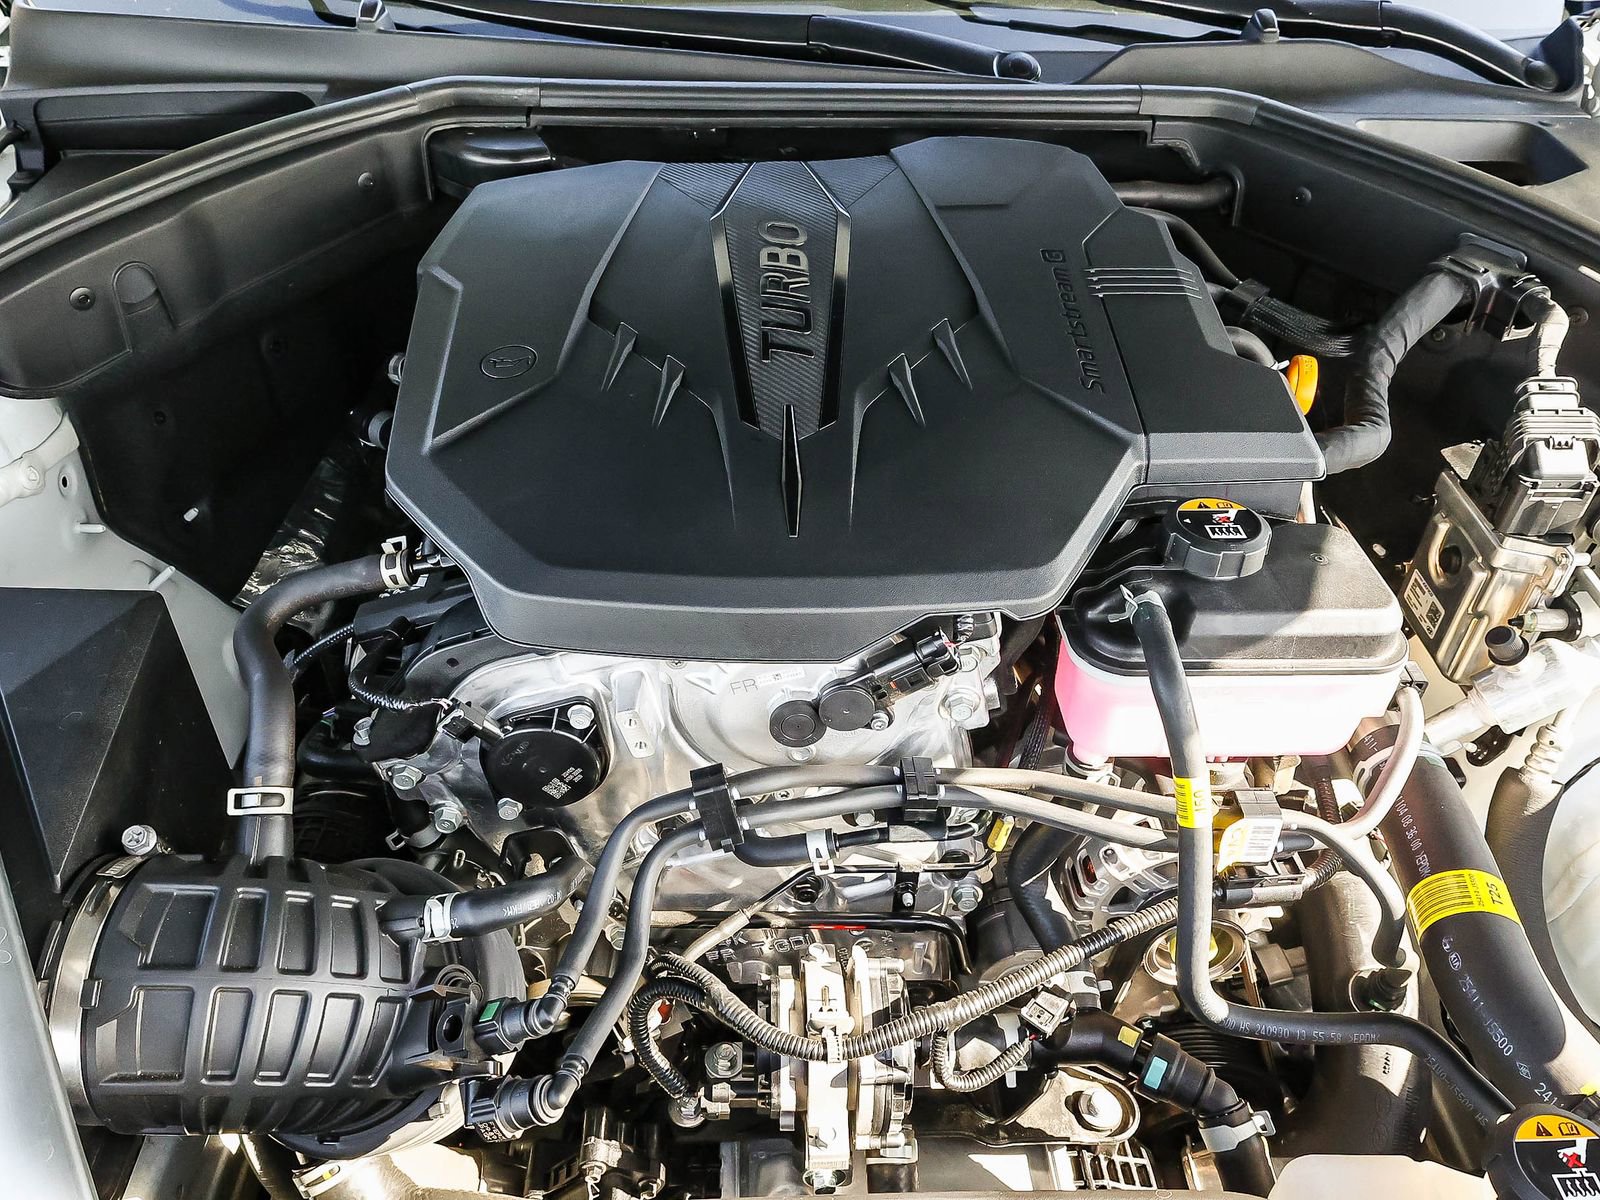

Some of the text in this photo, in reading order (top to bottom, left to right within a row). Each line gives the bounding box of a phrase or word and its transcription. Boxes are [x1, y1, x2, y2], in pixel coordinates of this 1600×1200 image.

[758, 221, 815, 363] TURBO
[1051, 266, 1106, 395] Smartstream
[729, 678, 759, 696] FR
[1486, 882, 1505, 905] T25
[1448, 951, 1464, 972] KIA
